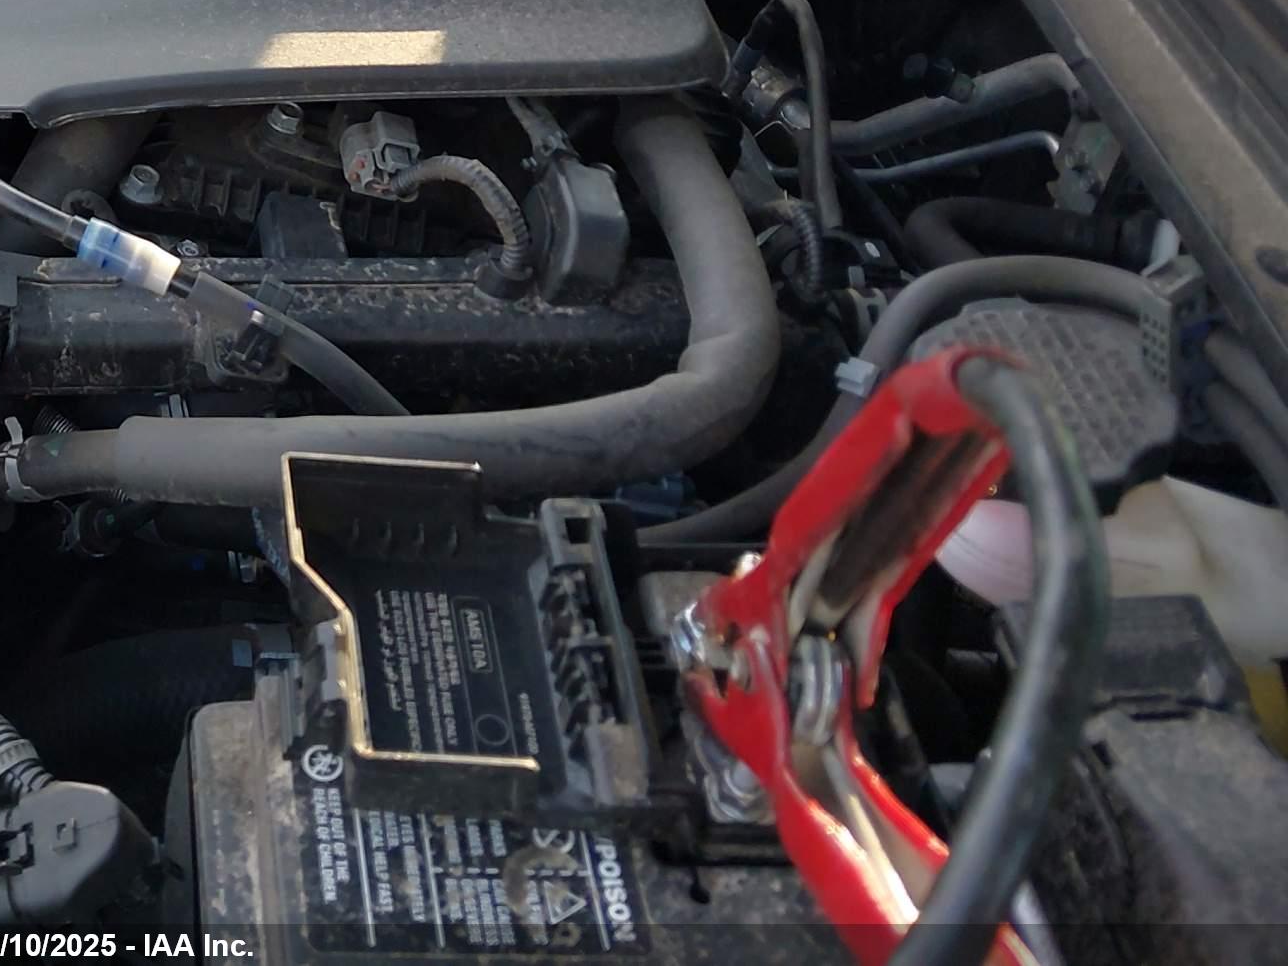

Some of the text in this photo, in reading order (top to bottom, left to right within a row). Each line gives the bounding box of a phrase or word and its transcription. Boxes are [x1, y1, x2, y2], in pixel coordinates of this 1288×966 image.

[465, 609, 488, 669] AMS 10A
[445, 717, 459, 746] ONLY
[313, 788, 337, 904] REACH OF CHILDREN.
[327, 788, 350, 883] KEEP OUT OF THE
[374, 851, 389, 882] HELP
